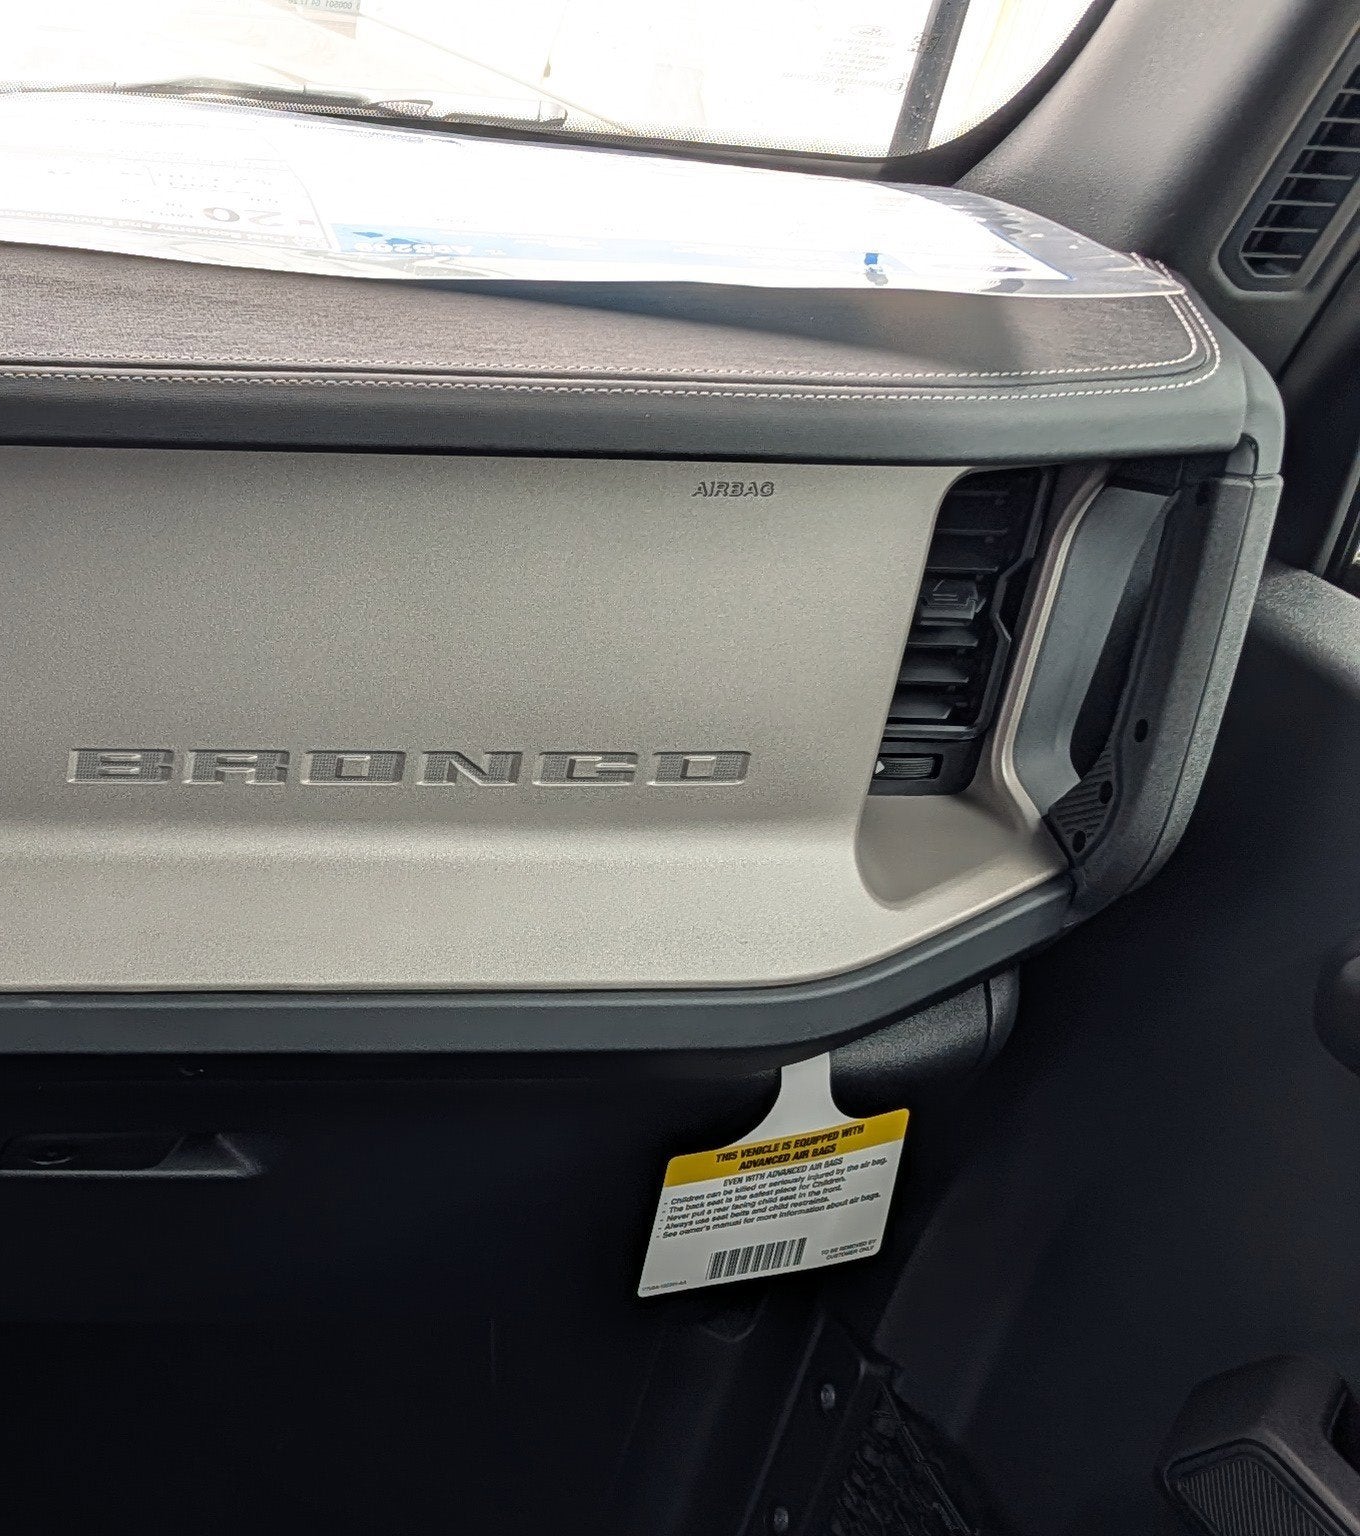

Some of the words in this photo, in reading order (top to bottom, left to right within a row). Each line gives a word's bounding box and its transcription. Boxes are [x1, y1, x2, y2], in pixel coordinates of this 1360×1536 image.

[691, 481, 775, 497] AIRBAG
[66, 748, 752, 787] BRONCO
[716, 1150, 737, 1162] THIS
[741, 1142, 779, 1158] VEHICLE
[782, 1140, 791, 1150] IS
[793, 1130, 838, 1148] EQUIPPED
[841, 1124, 864, 1137] WITH
[738, 1152, 789, 1170] ADVANCED
[792, 1149, 808, 1160] AIR
[812, 1143, 836, 1156] BAGS
[723, 1176, 742, 1186] EVEN
[745, 1172, 765, 1182] WITH
[766, 1164, 806, 1179] ADVANCED
[809, 1161, 821, 1171] AIR
[824, 1157, 842, 1167] BAGS
